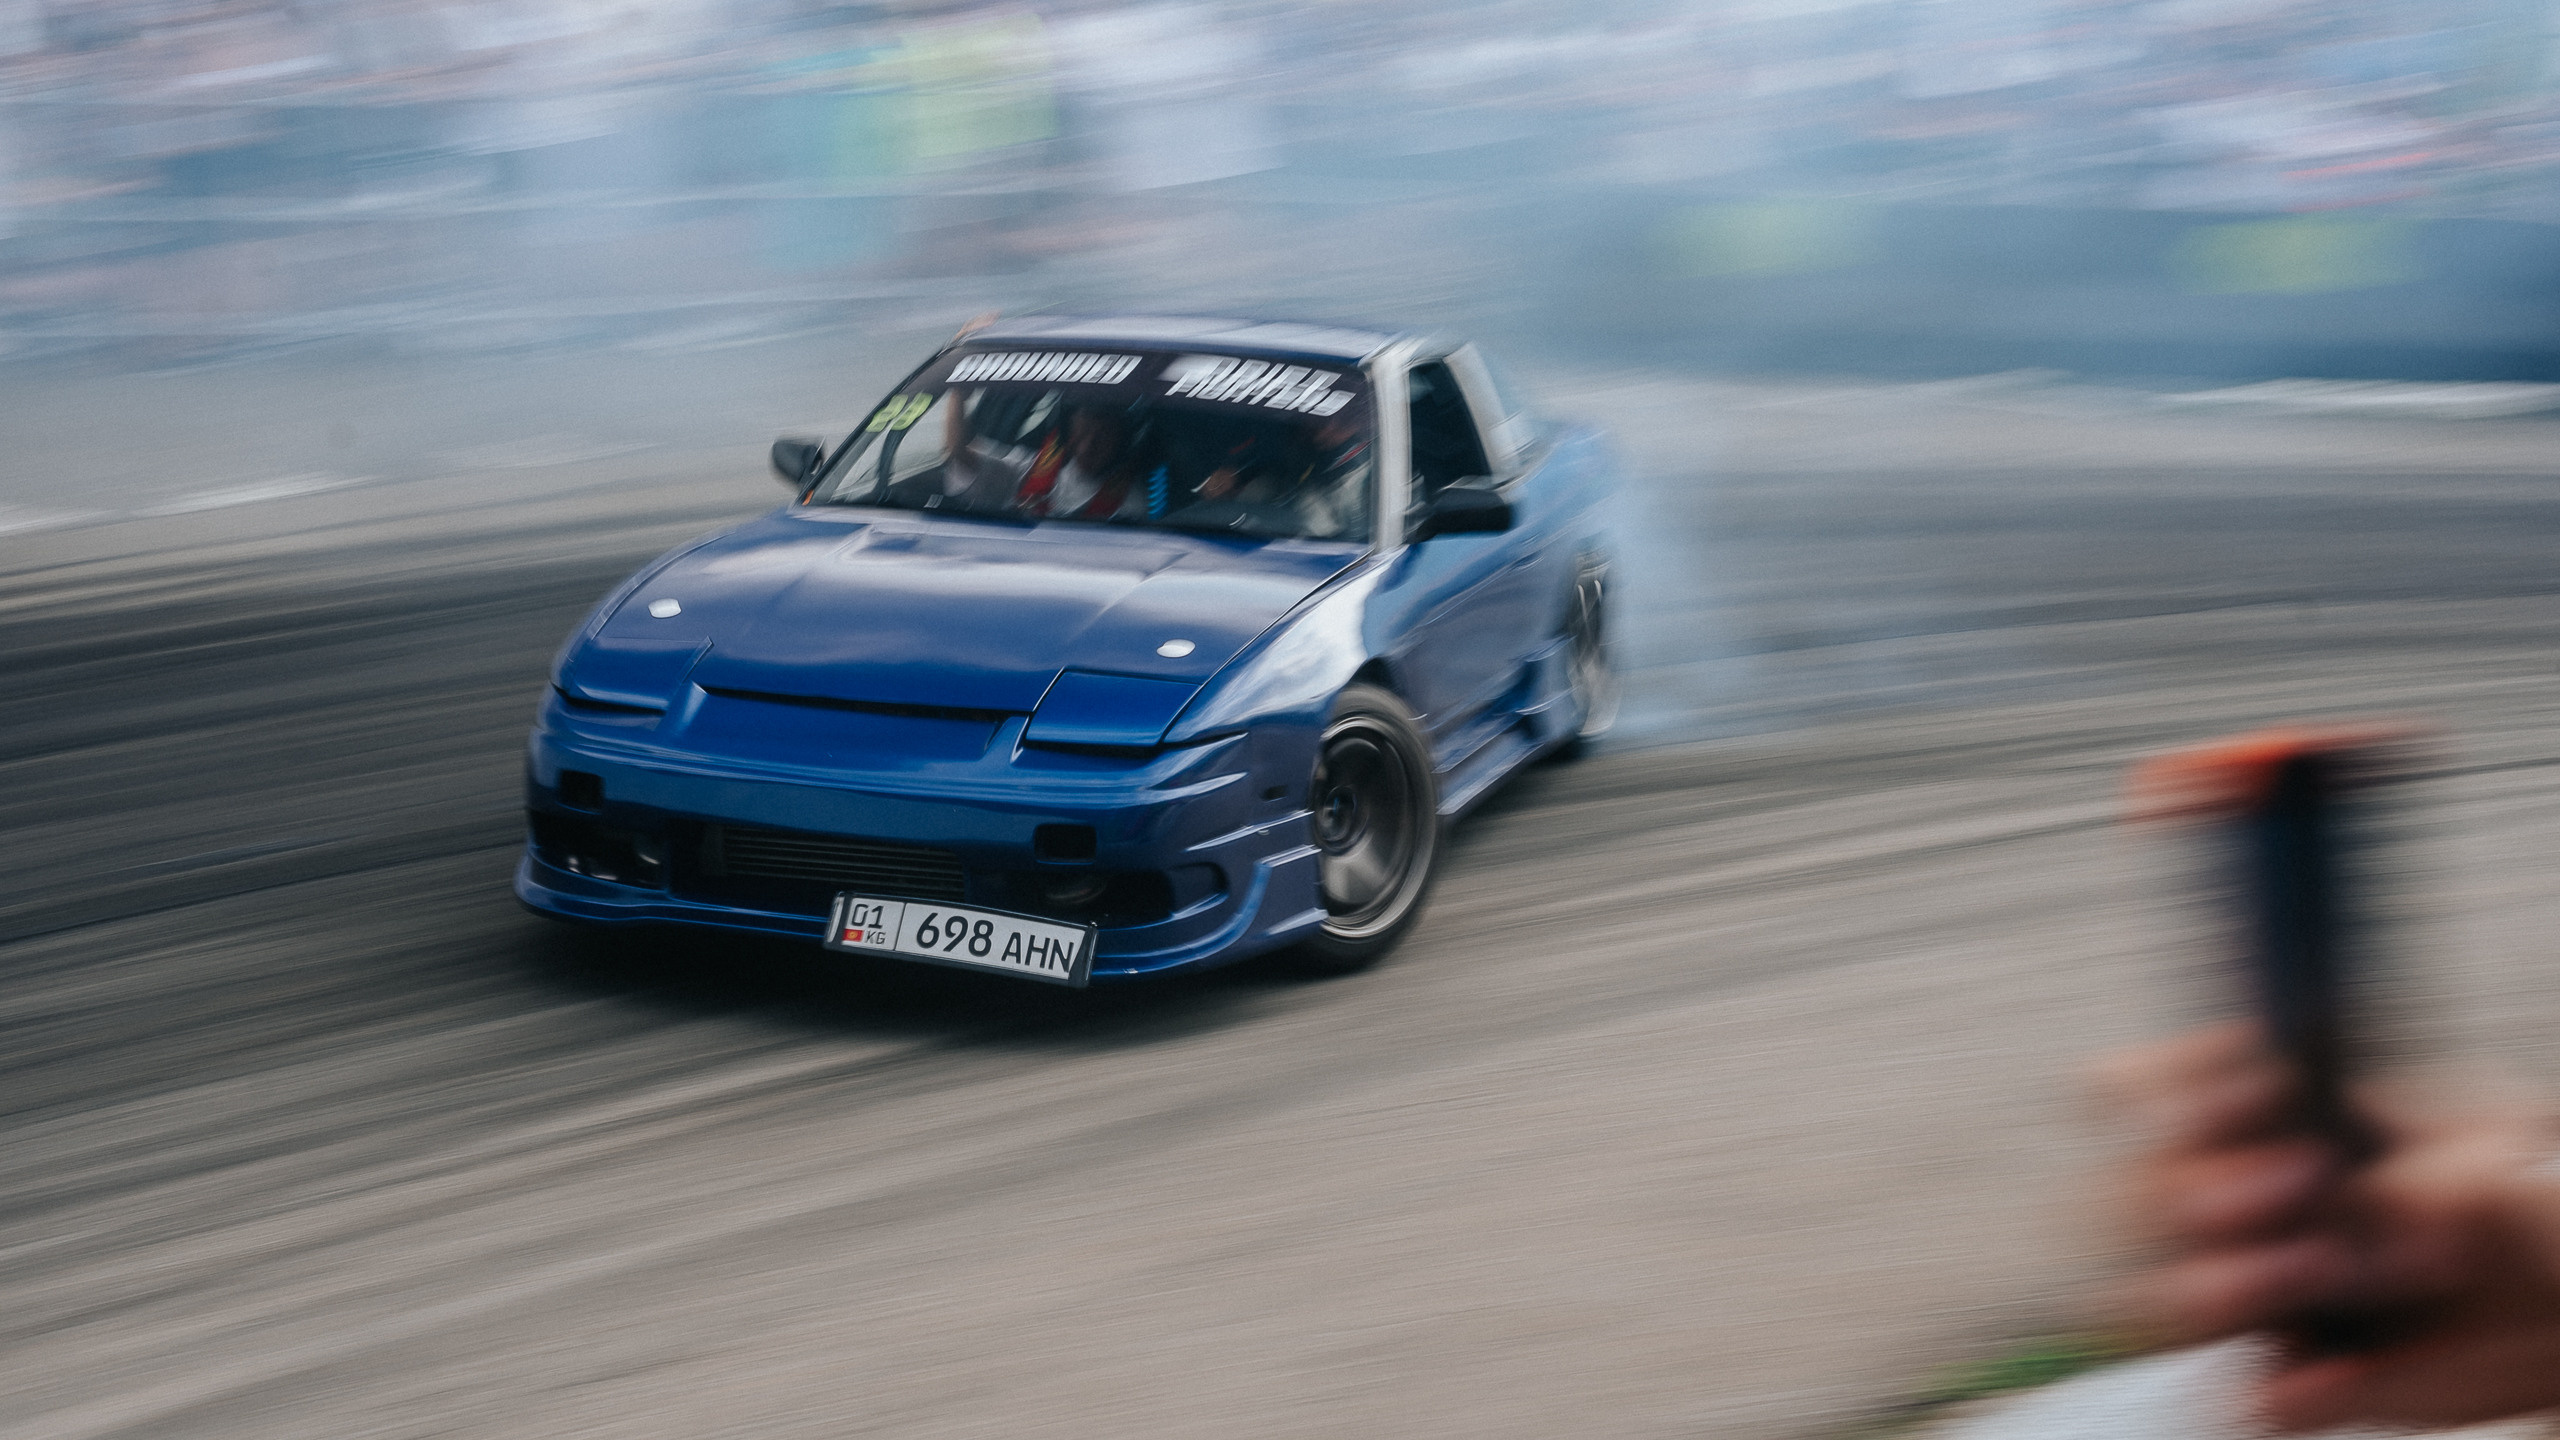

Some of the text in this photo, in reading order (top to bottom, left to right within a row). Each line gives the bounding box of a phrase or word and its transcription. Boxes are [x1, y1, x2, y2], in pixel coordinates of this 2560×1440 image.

[850, 903, 884, 929] 01
[863, 930, 886, 945] KG
[916, 912, 1075, 973] 698 AHN
